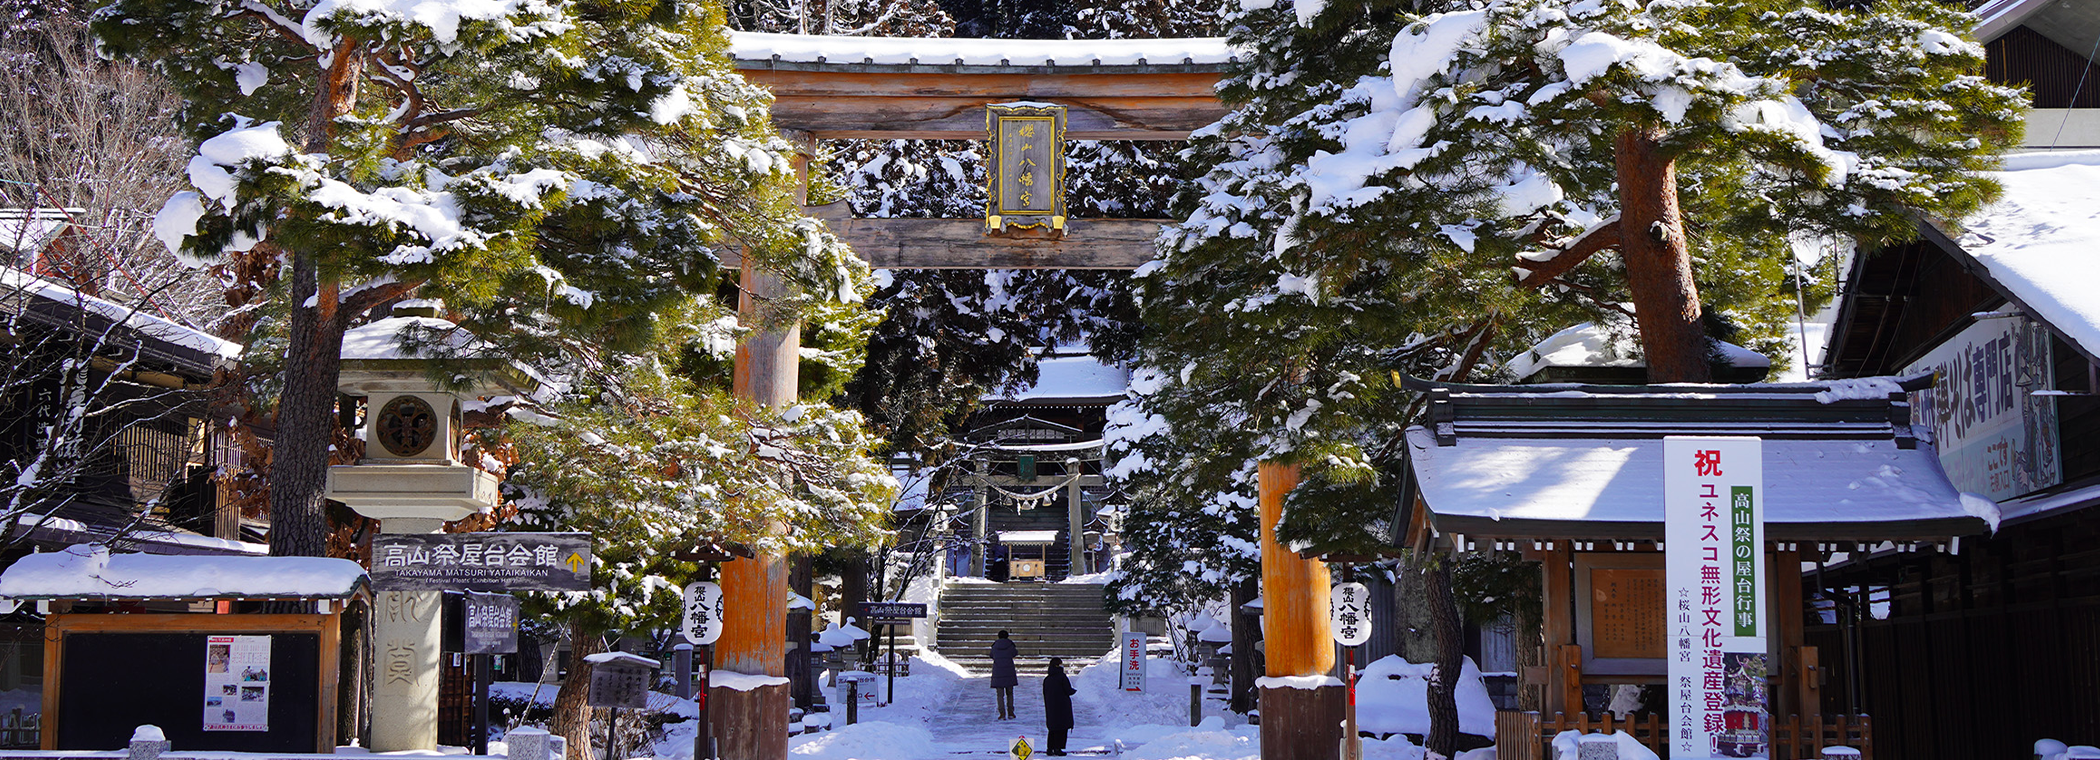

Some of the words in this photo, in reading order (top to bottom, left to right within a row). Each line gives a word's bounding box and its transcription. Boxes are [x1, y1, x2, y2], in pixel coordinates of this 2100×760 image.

[1694, 450, 1723, 476] 祝
[383, 542, 559, 567] 高山祭屋台会館
[1734, 493, 1753, 628] 高山祭の屋台行事
[395, 569, 443, 577] TAKAYAMA
[445, 569, 487, 577] MATSURI
[489, 569, 548, 577] YATAIKAIKAN
[1699, 484, 1726, 752] ユネスコ無形文化遺産登録!
[1129, 638, 1140, 670] お手洗
